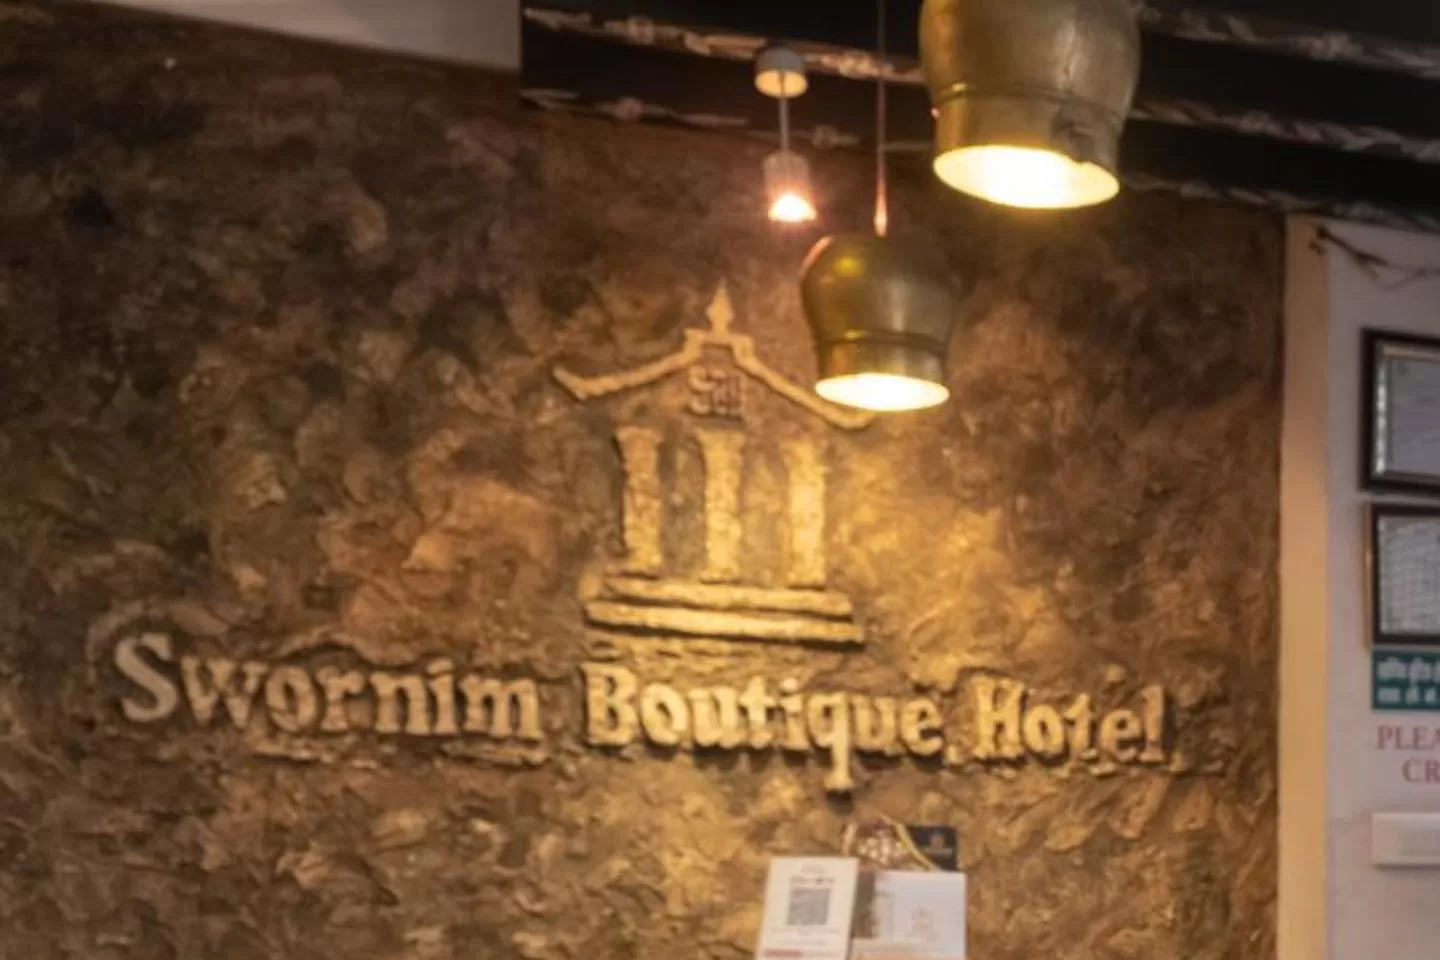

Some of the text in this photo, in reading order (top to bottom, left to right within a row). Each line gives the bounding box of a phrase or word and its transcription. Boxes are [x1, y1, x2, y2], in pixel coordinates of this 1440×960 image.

[114, 632, 1167, 792] Swornim Boutique Hotel
